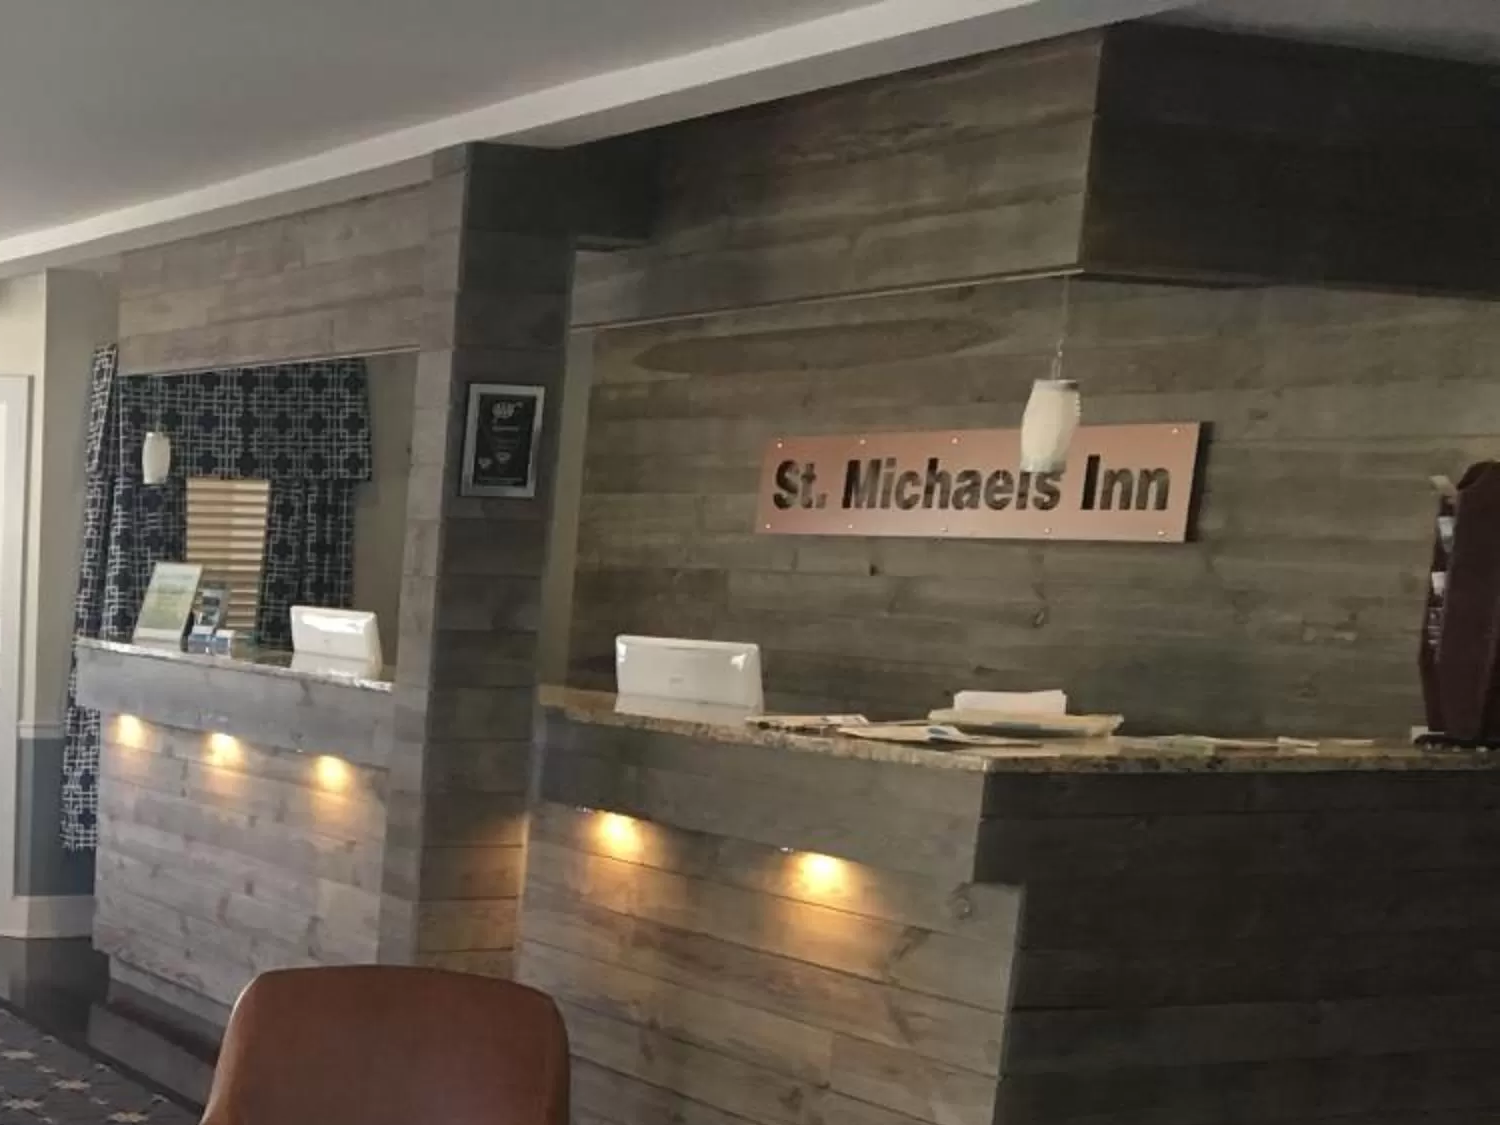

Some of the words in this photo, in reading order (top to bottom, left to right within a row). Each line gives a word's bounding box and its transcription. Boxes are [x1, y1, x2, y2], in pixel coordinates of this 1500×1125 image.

[773, 459, 827, 510] St.
[842, 457, 1064, 511] Michaels
[1080, 454, 1171, 511] Inn
